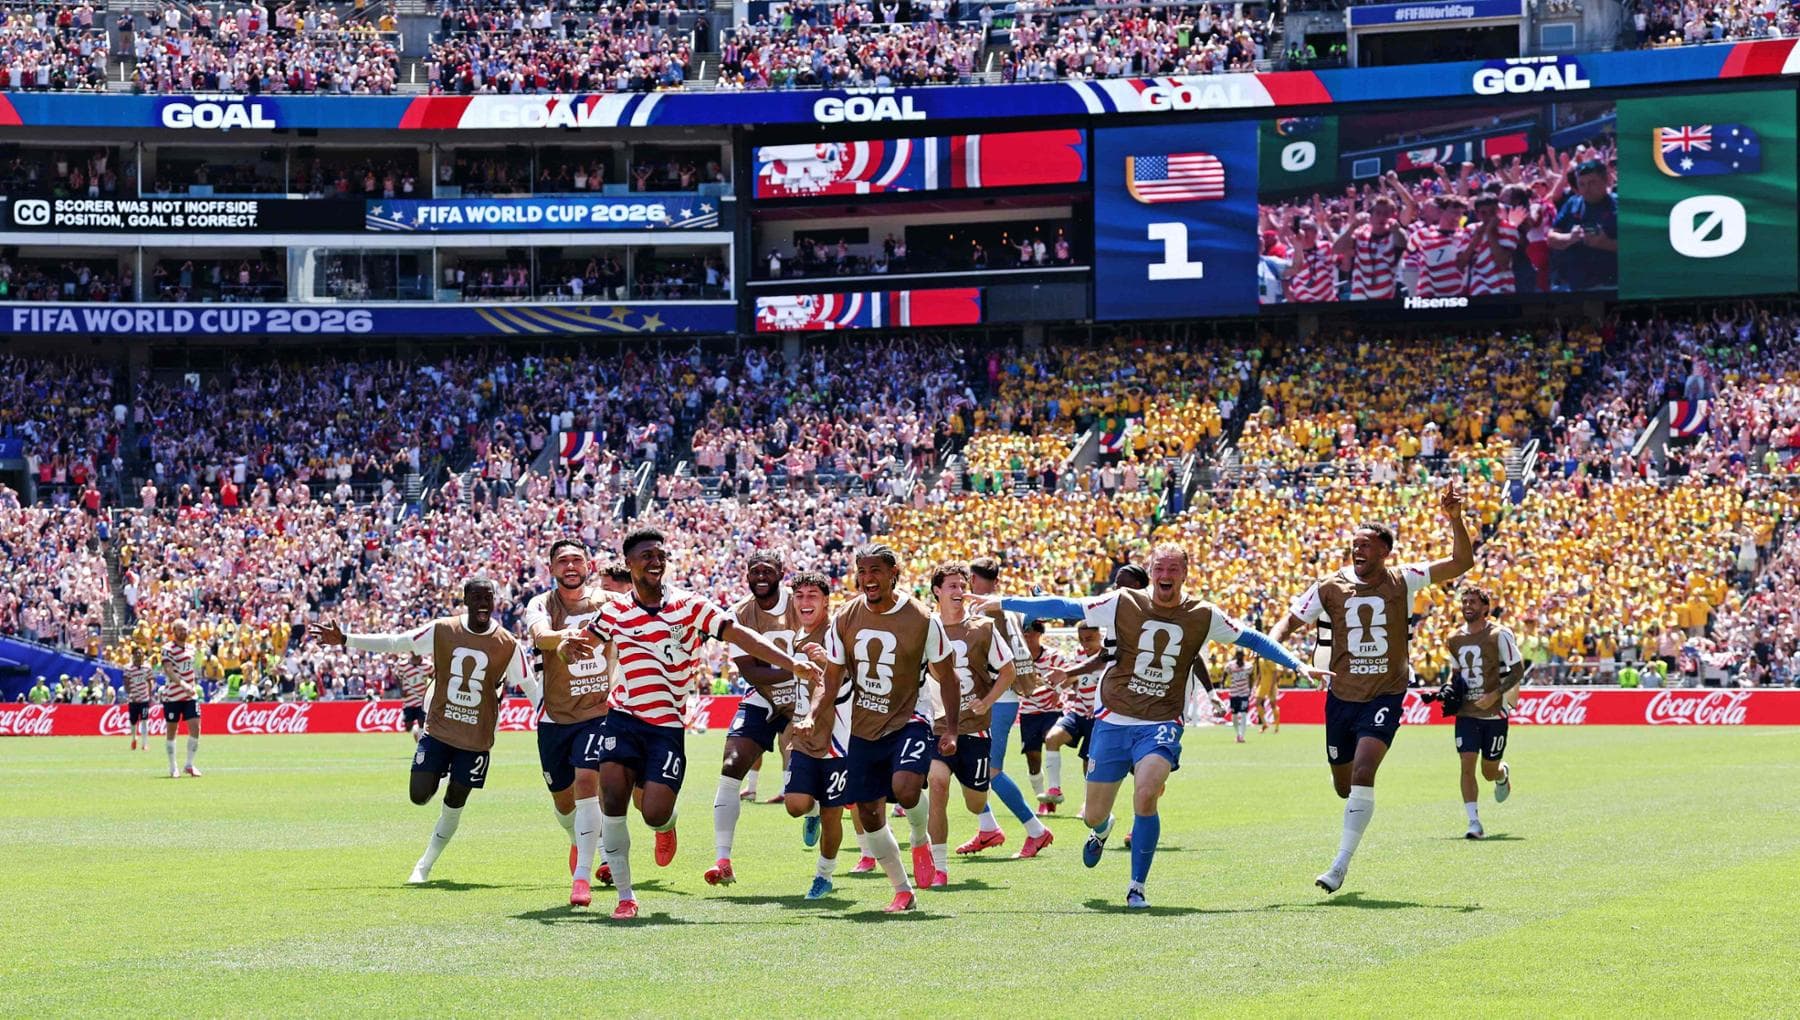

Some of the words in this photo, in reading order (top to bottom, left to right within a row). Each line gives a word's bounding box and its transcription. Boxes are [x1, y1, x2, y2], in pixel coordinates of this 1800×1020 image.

[1395, 5, 1475, 20] #FIFAWorldCup
[1472, 64, 1590, 95] GOAL
[1140, 83, 1255, 110] GOAL
[162, 103, 276, 129] GOAL
[814, 96, 927, 123] GOAL
[17, 204, 47, 221] CC
[55, 200, 114, 212] SCORER
[117, 201, 149, 213] WAS
[152, 201, 182, 213] NOT
[184, 201, 258, 214] INOFFSIDE
[418, 206, 463, 224] FIFA
[465, 206, 545, 223] WORLD
[546, 206, 588, 223] CUP
[591, 204, 666, 222] 2026
[55, 214, 125, 228] POSITION,
[128, 215, 168, 227] GOAL
[171, 215, 185, 227] IS
[187, 215, 258, 228] CORRECT.
[1147, 222, 1203, 280] 1
[1404, 295, 1468, 309] Hisense
[13, 308, 78, 332] FIFA
[83, 308, 195, 332] WORLD
[199, 308, 261, 332] CUP
[265, 308, 373, 332] 2026
[1359, 644, 1378, 652] FIFA
[580, 662, 598, 671] FIFA
[1144, 669, 1163, 679] FIFA
[1350, 664, 1388, 675] 2026
[570, 677, 596, 687] WORLD
[570, 682, 609, 697] 2026
[865, 680, 882, 689] FIFA
[1127, 682, 1166, 697] 2026
[456, 693, 472, 702] FIFA
[445, 703, 466, 713] WORLD
[1645, 689, 1752, 724] Coca-Cola
[227, 702, 312, 734] Coca-Cola
[444, 710, 478, 725] 2026
[1373, 706, 1390, 725] 6
[1154, 724, 1177, 743] 25
[900, 738, 926, 760] 12
[1491, 736, 1504, 752] 10
[470, 755, 489, 776] 21
[662, 751, 681, 776] 16
[975, 758, 988, 779] 11
[828, 769, 848, 793] 26
